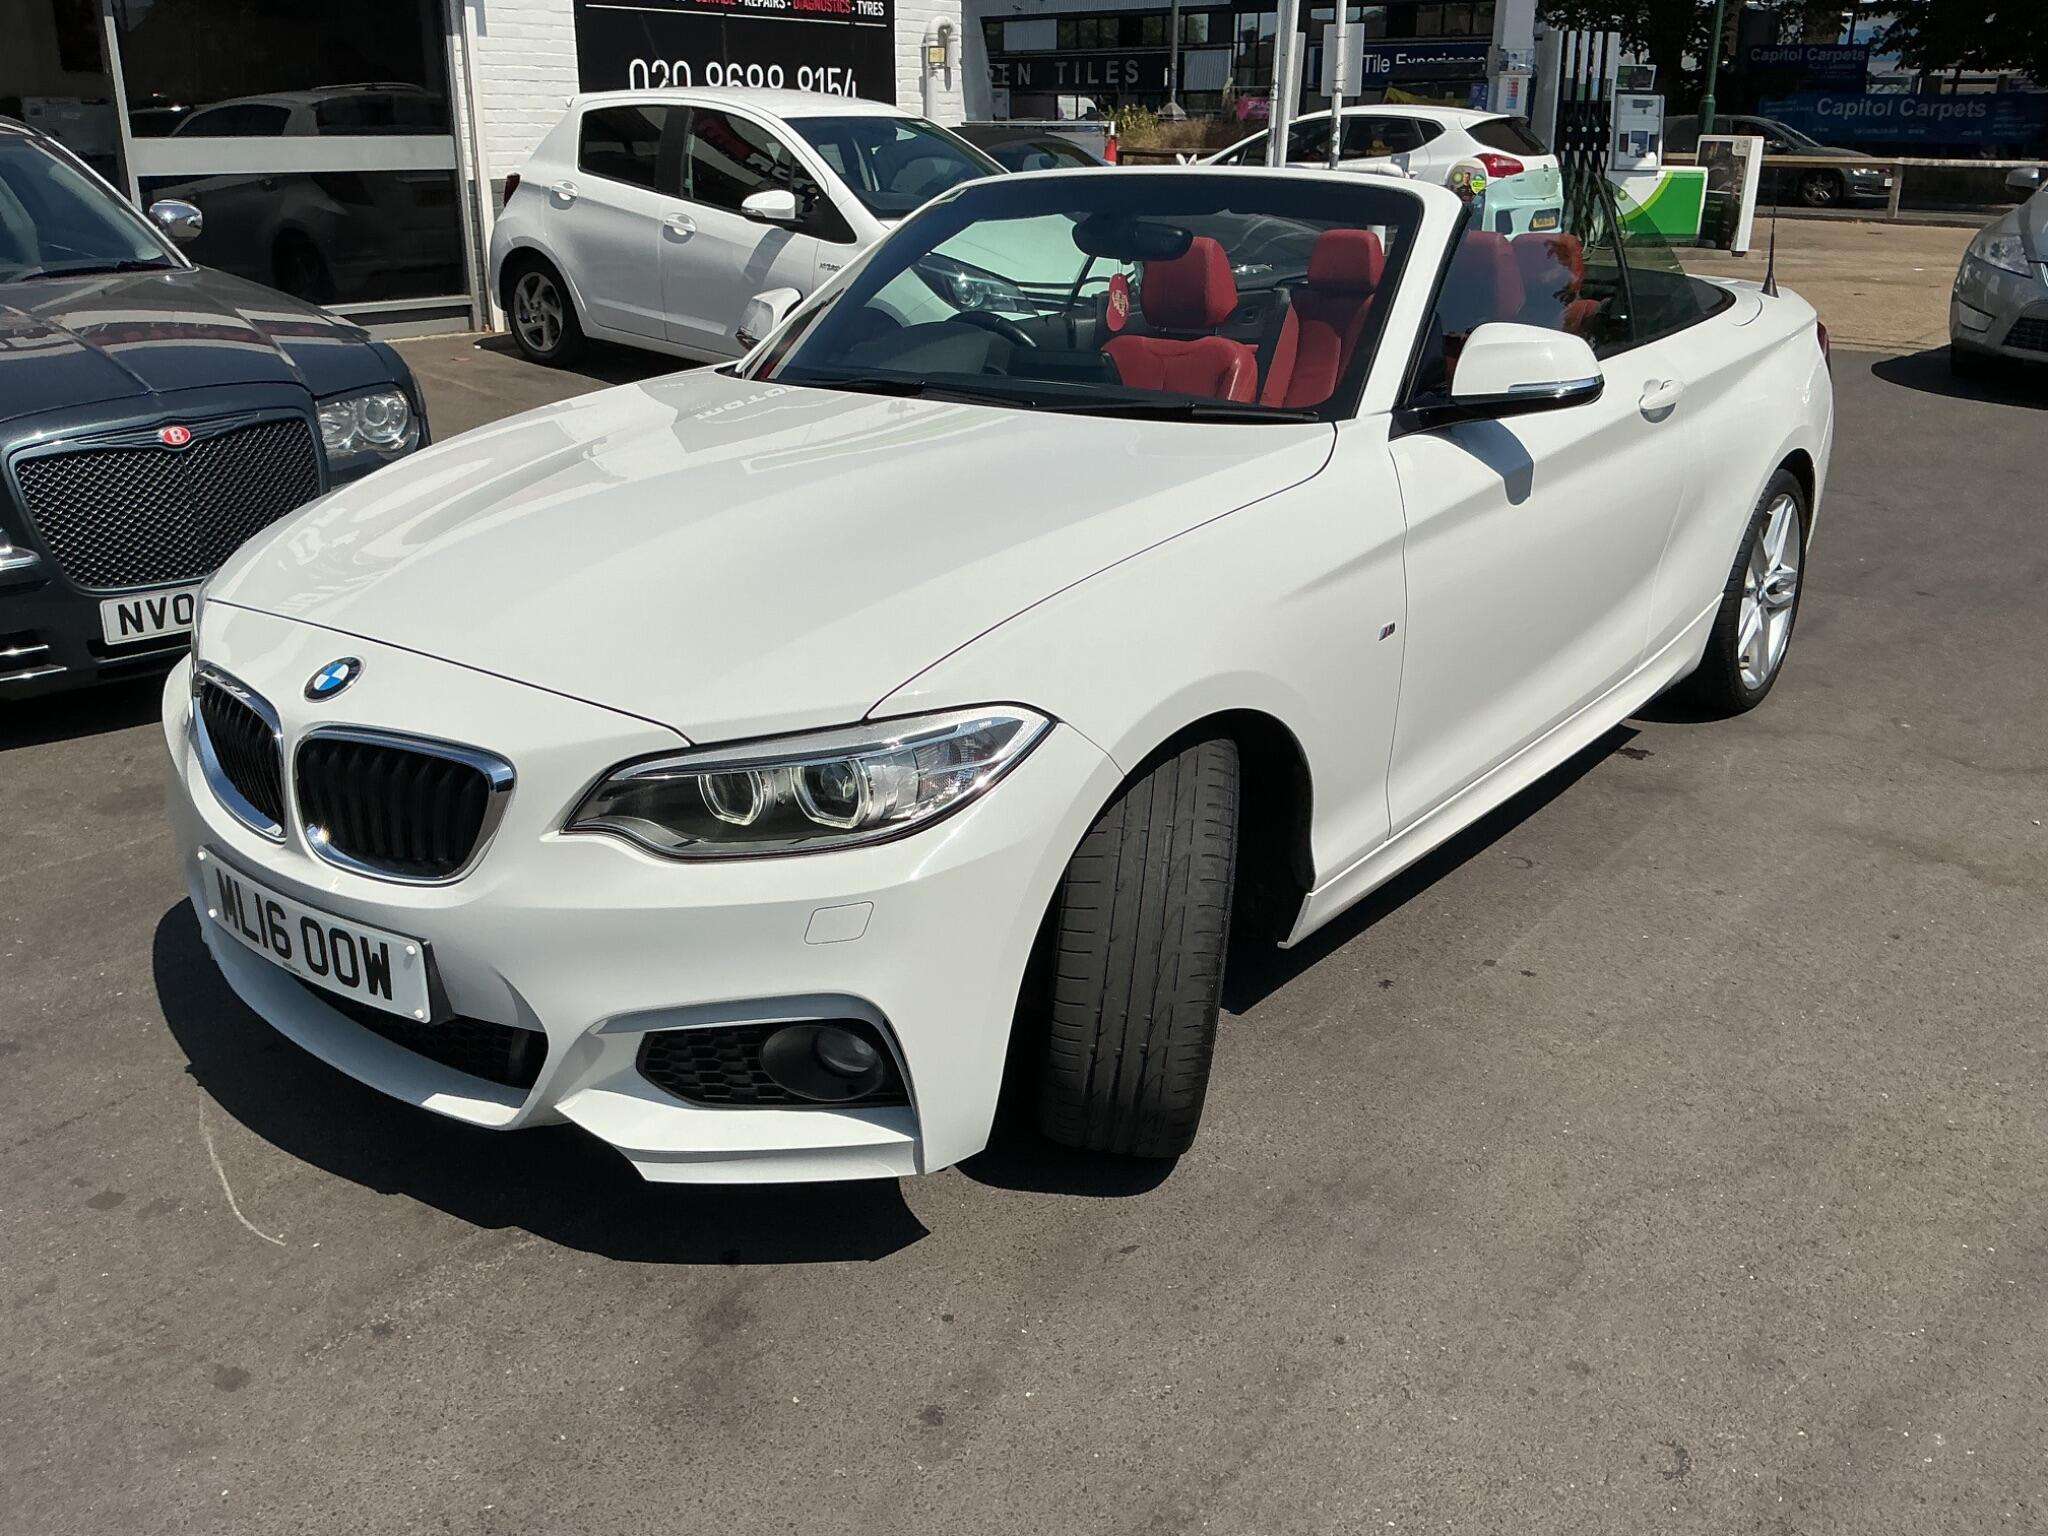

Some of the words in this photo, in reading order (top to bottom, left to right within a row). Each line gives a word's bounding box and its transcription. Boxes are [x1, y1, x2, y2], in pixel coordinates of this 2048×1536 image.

[857, 1, 885, 16] TYRES
[1363, 54, 1391, 73] Tile
[1750, 48, 1803, 63] Capitol
[1806, 48, 1866, 63] Carpets
[629, 58, 692, 90] 020
[1054, 60, 1140, 85] TILES
[1817, 98, 1893, 120] Capitol
[1899, 98, 1987, 121] Carpets
[215, 867, 293, 961] ML16
